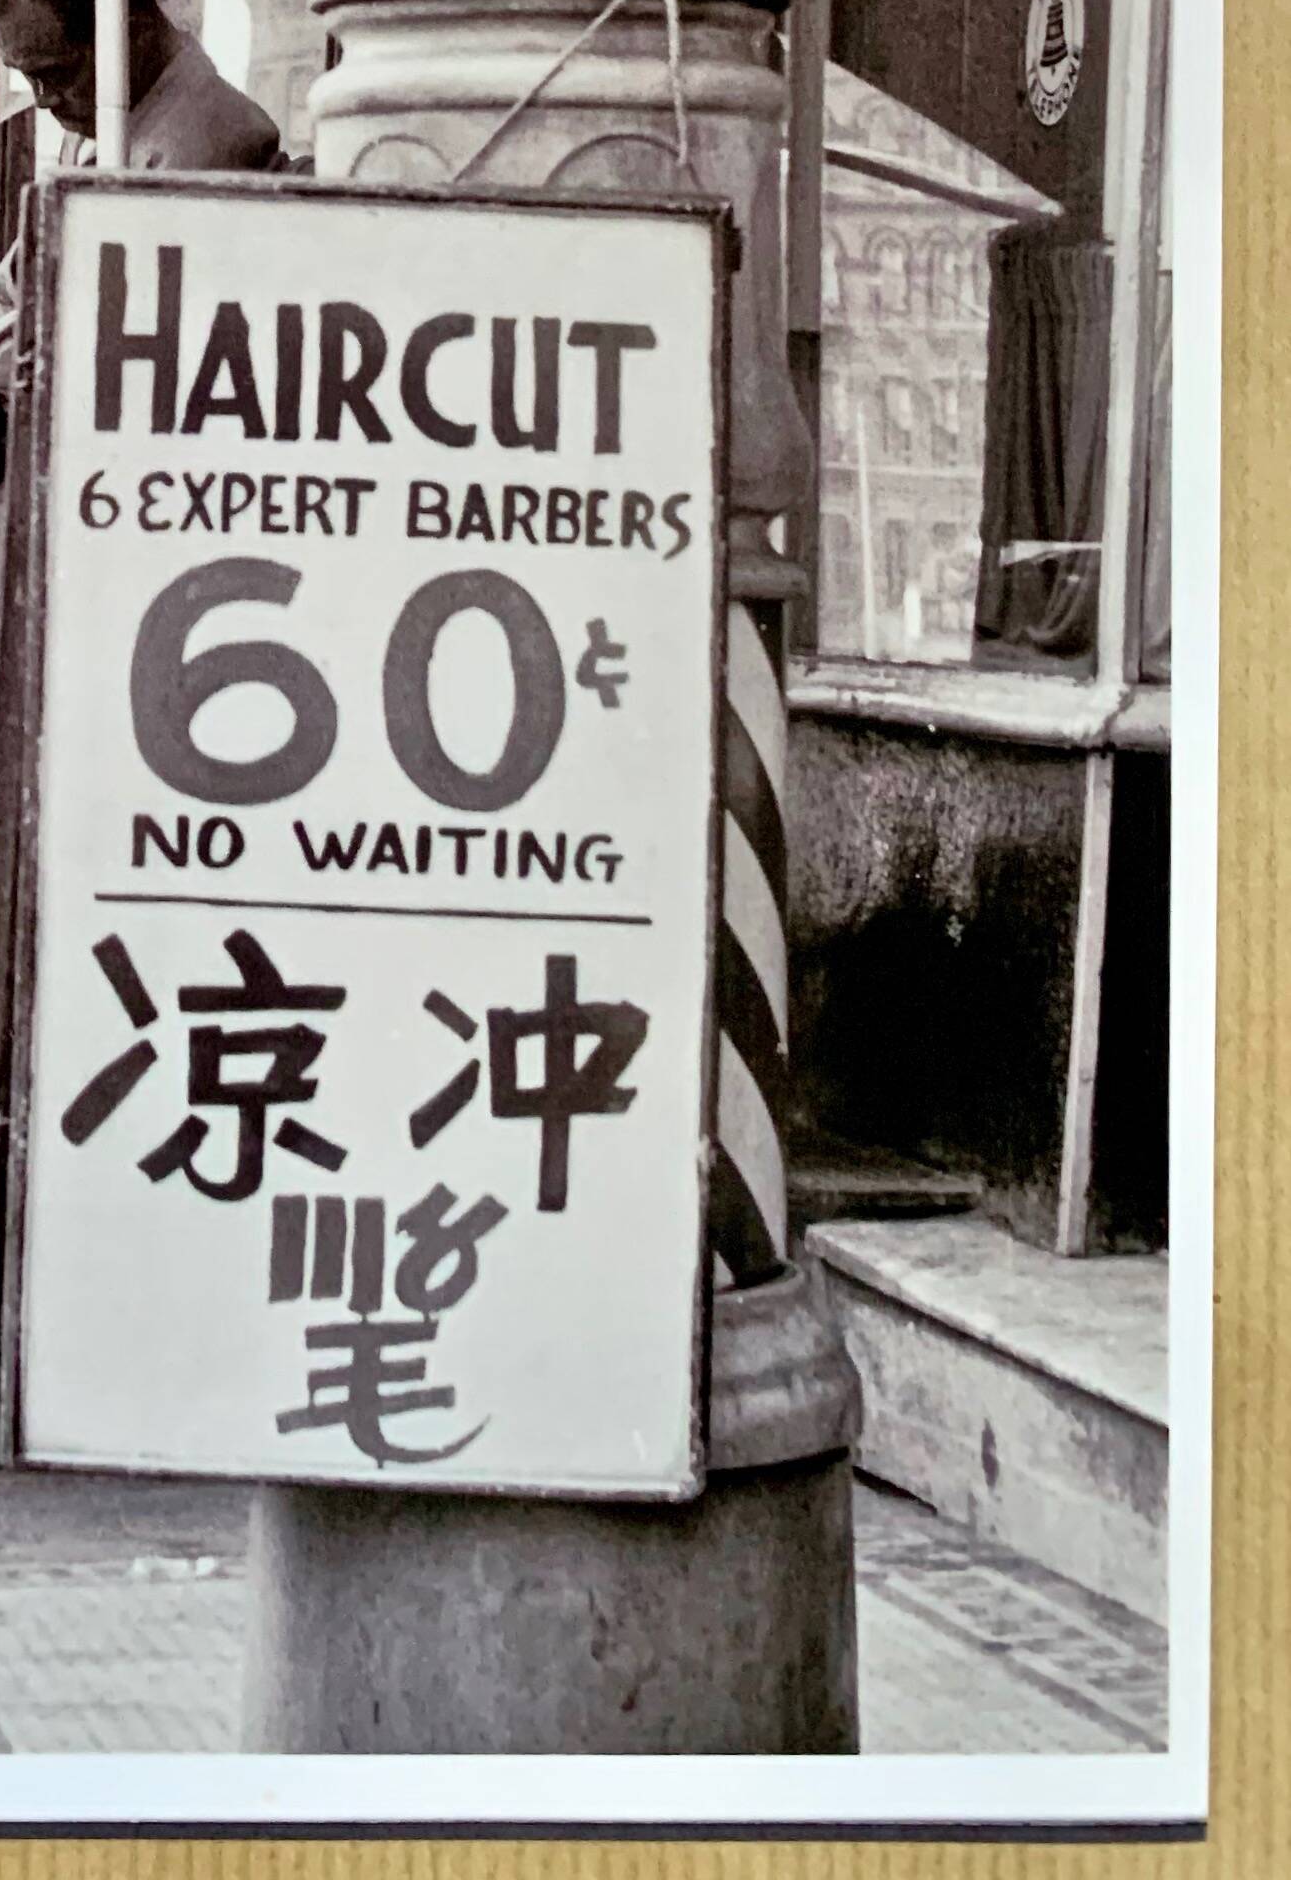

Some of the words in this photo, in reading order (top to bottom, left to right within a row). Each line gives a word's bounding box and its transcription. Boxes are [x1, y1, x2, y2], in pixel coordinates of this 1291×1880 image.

[93, 241, 657, 455] HAIRCUT
[78, 469, 120, 529] 6
[138, 470, 377, 537] EXPERT
[406, 480, 693, 560] BARBERS
[131, 814, 245, 868] NO
[293, 819, 625, 884] WAITING
